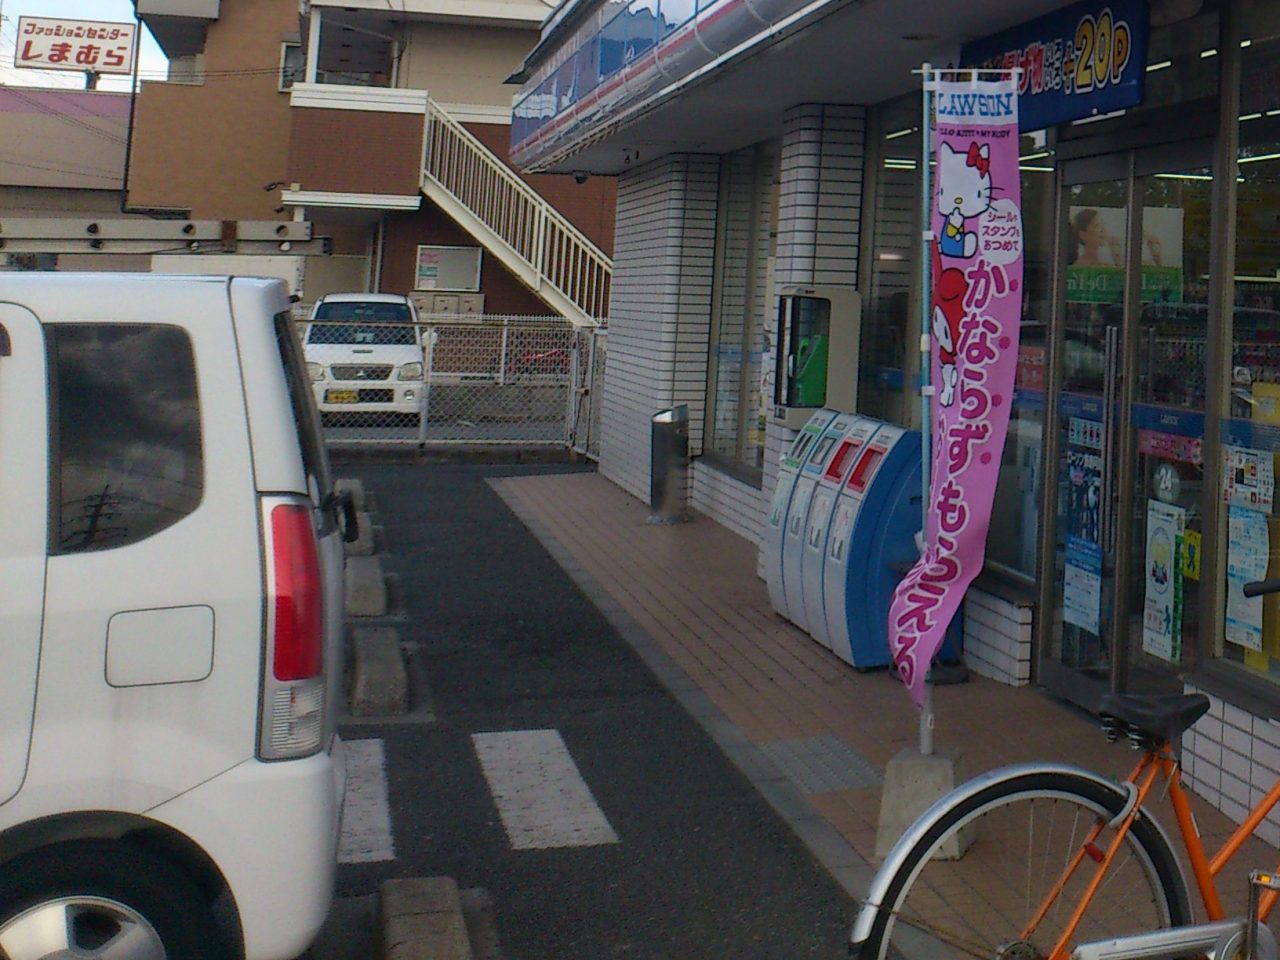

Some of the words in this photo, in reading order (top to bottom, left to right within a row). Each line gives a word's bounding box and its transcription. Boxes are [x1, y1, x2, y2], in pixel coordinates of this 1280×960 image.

[24, 23, 129, 40] ファッションセンター
[21, 39, 128, 67] しまむら
[938, 93, 1014, 116] LAWSON
[895, 257, 1010, 689] かならずもらえる
